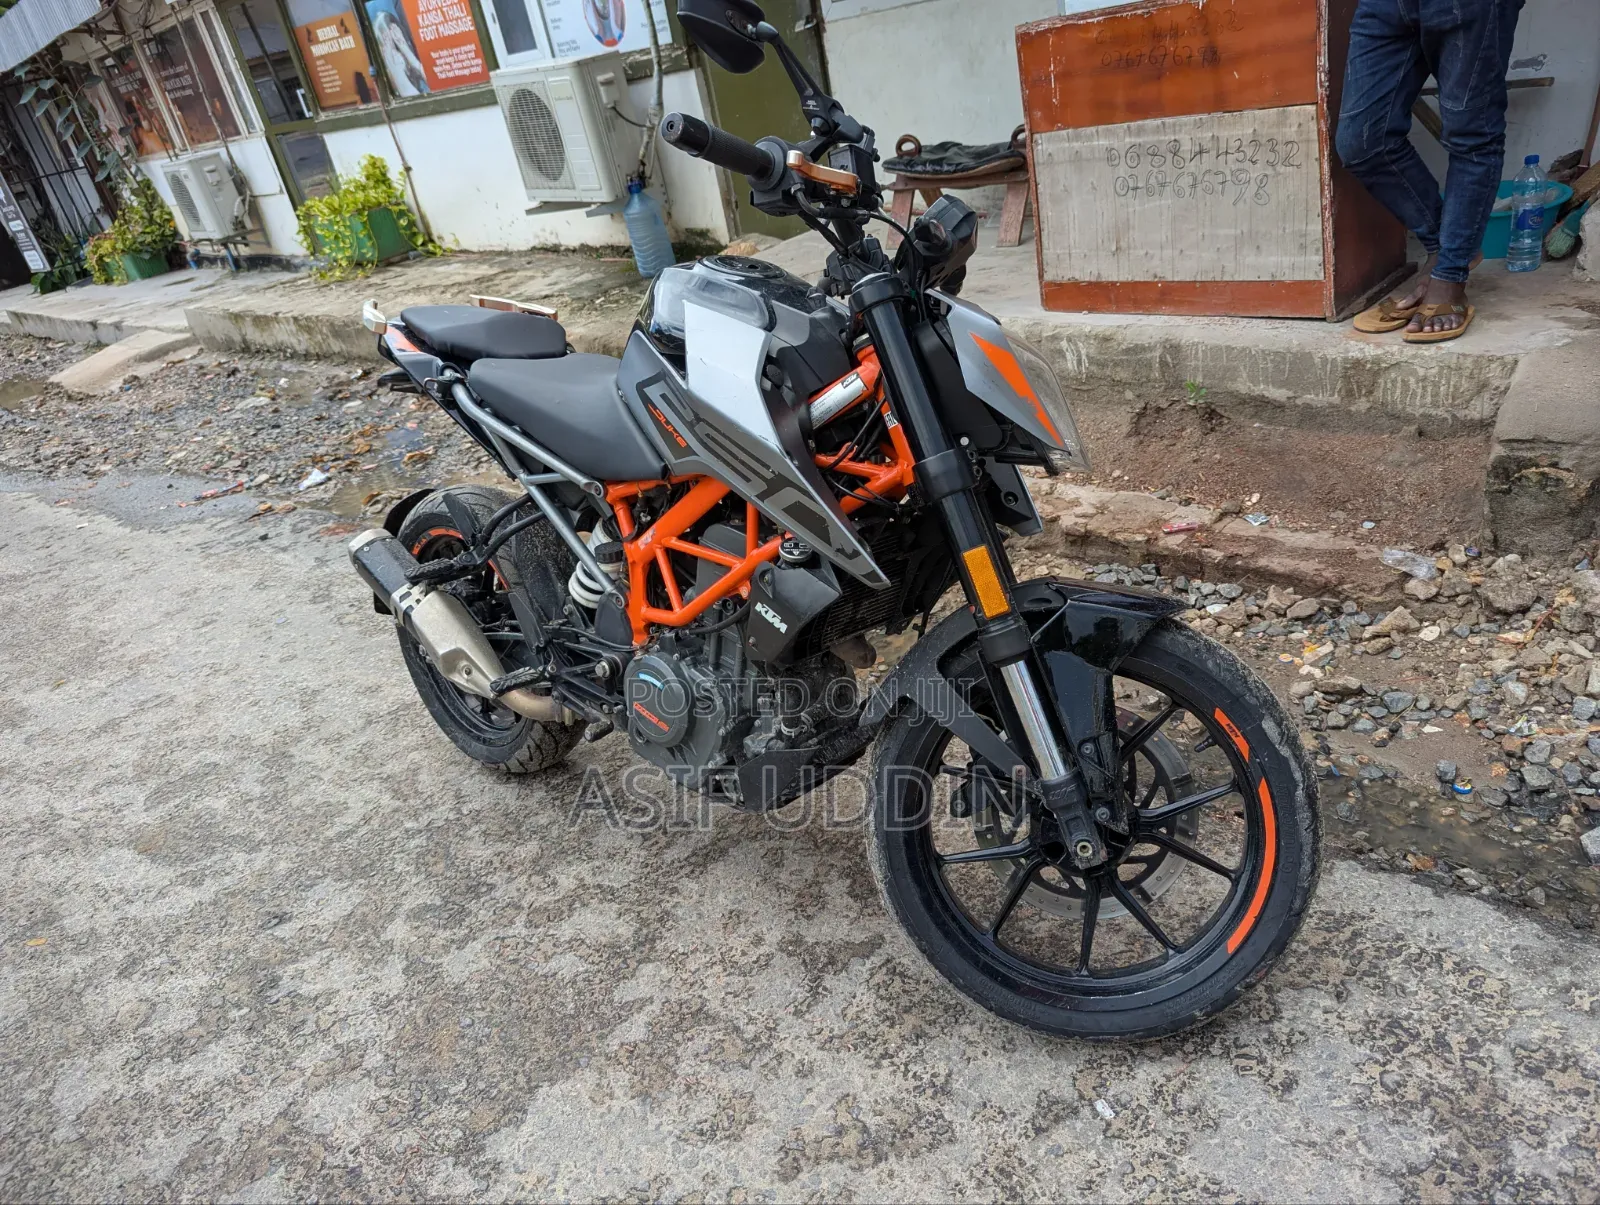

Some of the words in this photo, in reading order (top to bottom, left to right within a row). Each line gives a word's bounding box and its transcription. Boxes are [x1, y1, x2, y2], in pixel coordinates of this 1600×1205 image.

[417, 9, 445, 28] KANSA
[443, 2, 467, 21] THALI
[419, 24, 439, 42] FOOT
[437, 16, 475, 38] MASSAGE
[1105, 136, 1302, 170] 0688443232
[1114, 168, 1271, 206] 0767676798
[647, 403, 688, 448] DUKE
[754, 601, 788, 634] KTM
